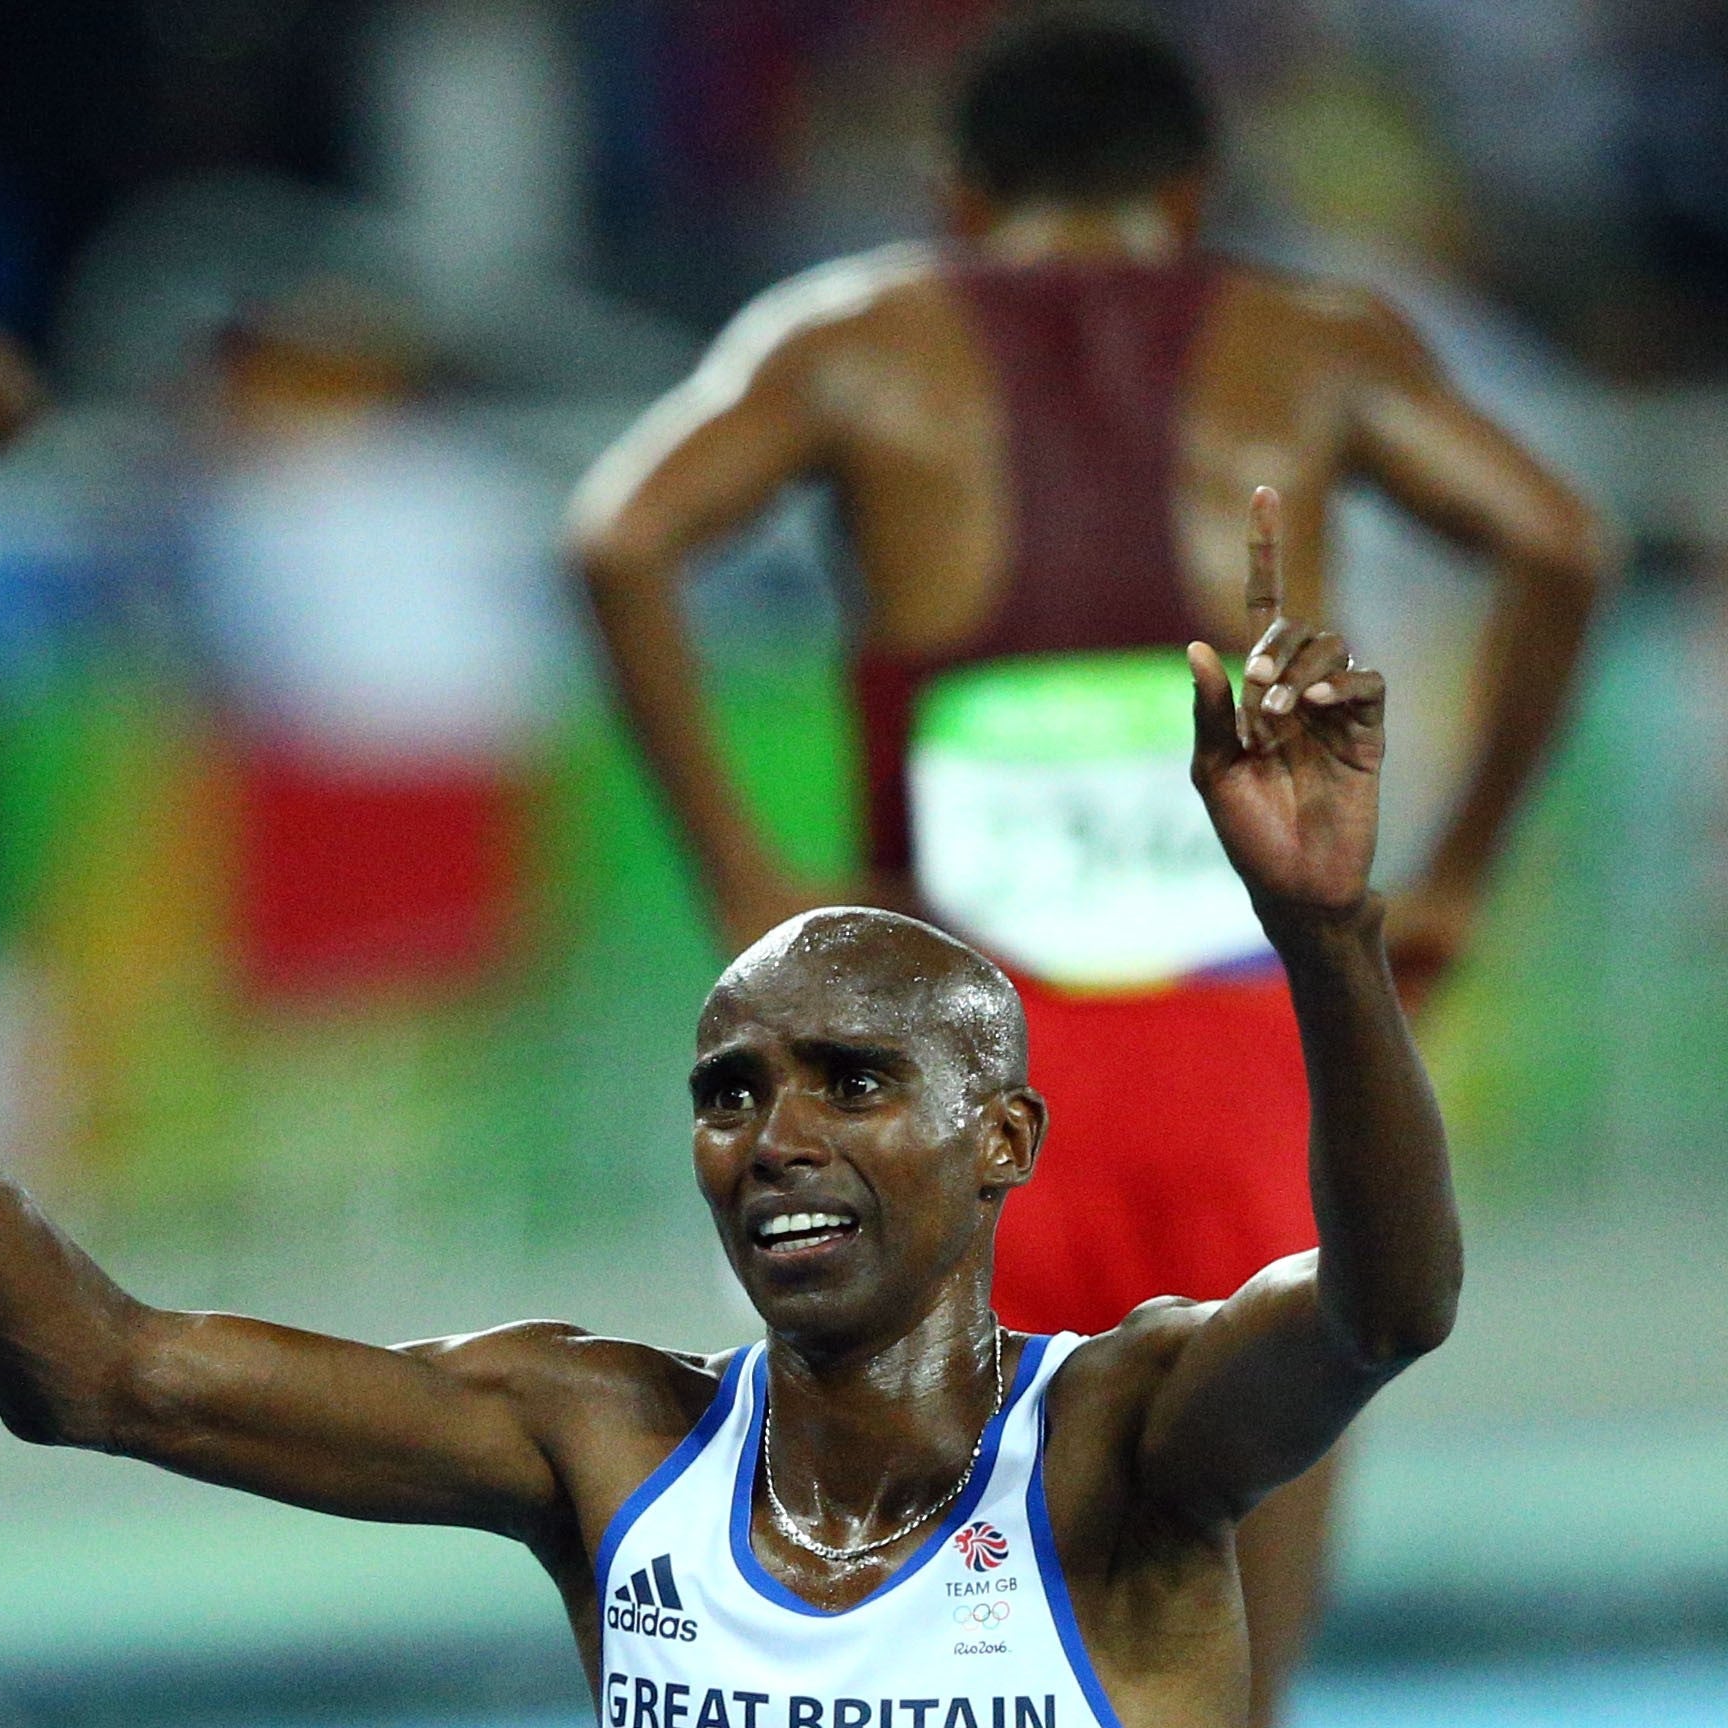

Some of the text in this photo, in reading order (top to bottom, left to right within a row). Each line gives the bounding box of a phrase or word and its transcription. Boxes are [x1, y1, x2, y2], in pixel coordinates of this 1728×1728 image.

[945, 1577, 1018, 1597] TEAM GB
[607, 1602, 698, 1643] adidas
